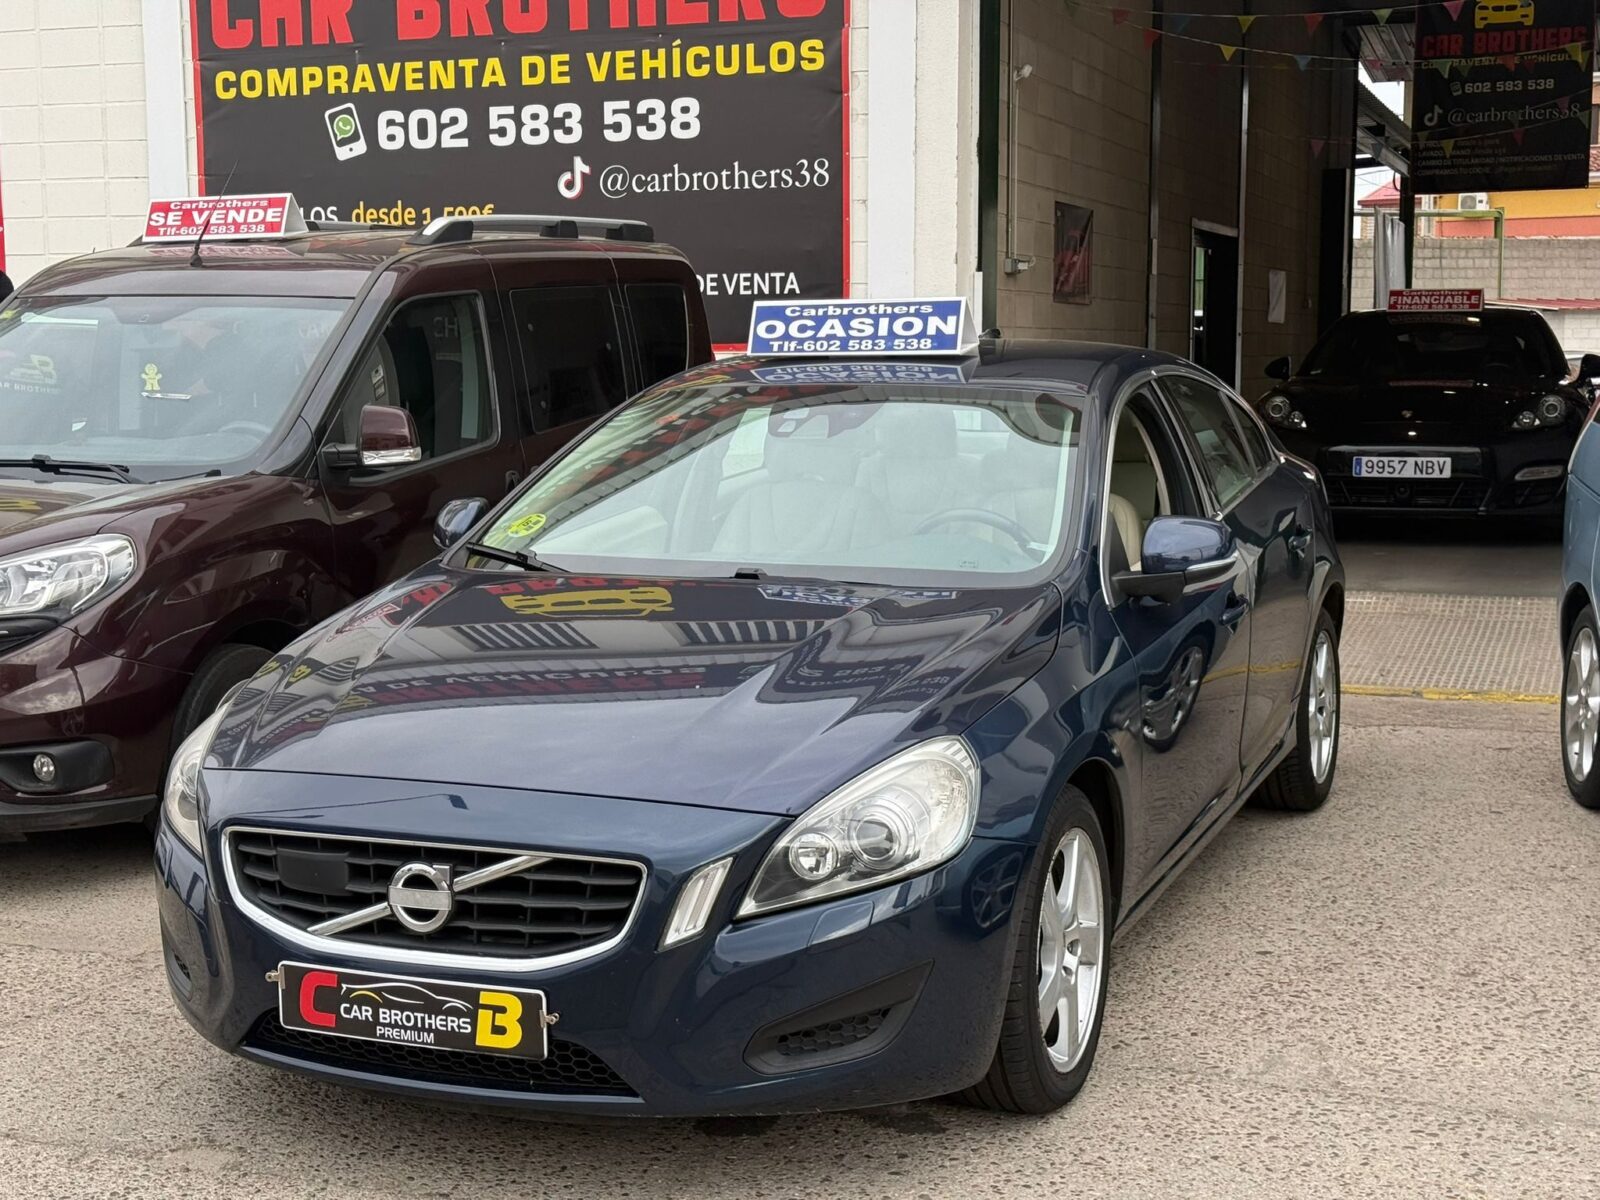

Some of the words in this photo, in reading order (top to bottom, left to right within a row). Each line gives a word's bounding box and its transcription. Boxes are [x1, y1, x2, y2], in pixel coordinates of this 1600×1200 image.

[211, 0, 353, 49] CAR
[397, 0, 826, 41] BROT
[1423, 34, 1463, 57] CAR
[215, 57, 506, 100] COMPRAVENTA
[521, 53, 571, 86] DE
[586, 38, 825, 82] VEHÍCULOS
[1464, 82, 1491, 93] 602
[1496, 80, 1522, 91] 583
[1528, 79, 1555, 90] 538
[377, 108, 469, 150] 602
[488, 102, 583, 147] 583
[603, 97, 701, 142] 538
[600, 158, 830, 199] @carbrothers38
[170, 199, 268, 210] Carbrothers
[351, 200, 416, 226] desde
[150, 211, 183, 226] SE
[192, 207, 282, 225] VENDE
[158, 225, 204, 236] Tlf-602
[209, 225, 235, 234] 583
[239, 224, 265, 233] 538
[722, 272, 800, 295] VENTA
[785, 304, 933, 316] Carbrothers
[1390, 295, 1479, 304] FINANCIABLE
[756, 315, 957, 339] OCASION
[769, 340, 841, 352] Tlf-602
[848, 339, 886, 351] 583
[893, 338, 932, 350] 538
[1365, 459, 1408, 475] 9957
[1414, 460, 1447, 475] NBV
[300, 971, 338, 1028] C
[340, 1003, 373, 1022] CAR
[379, 1008, 472, 1033] BROTHERS
[475, 991, 523, 1049] B
[376, 1025, 435, 1044] PREMIUM
